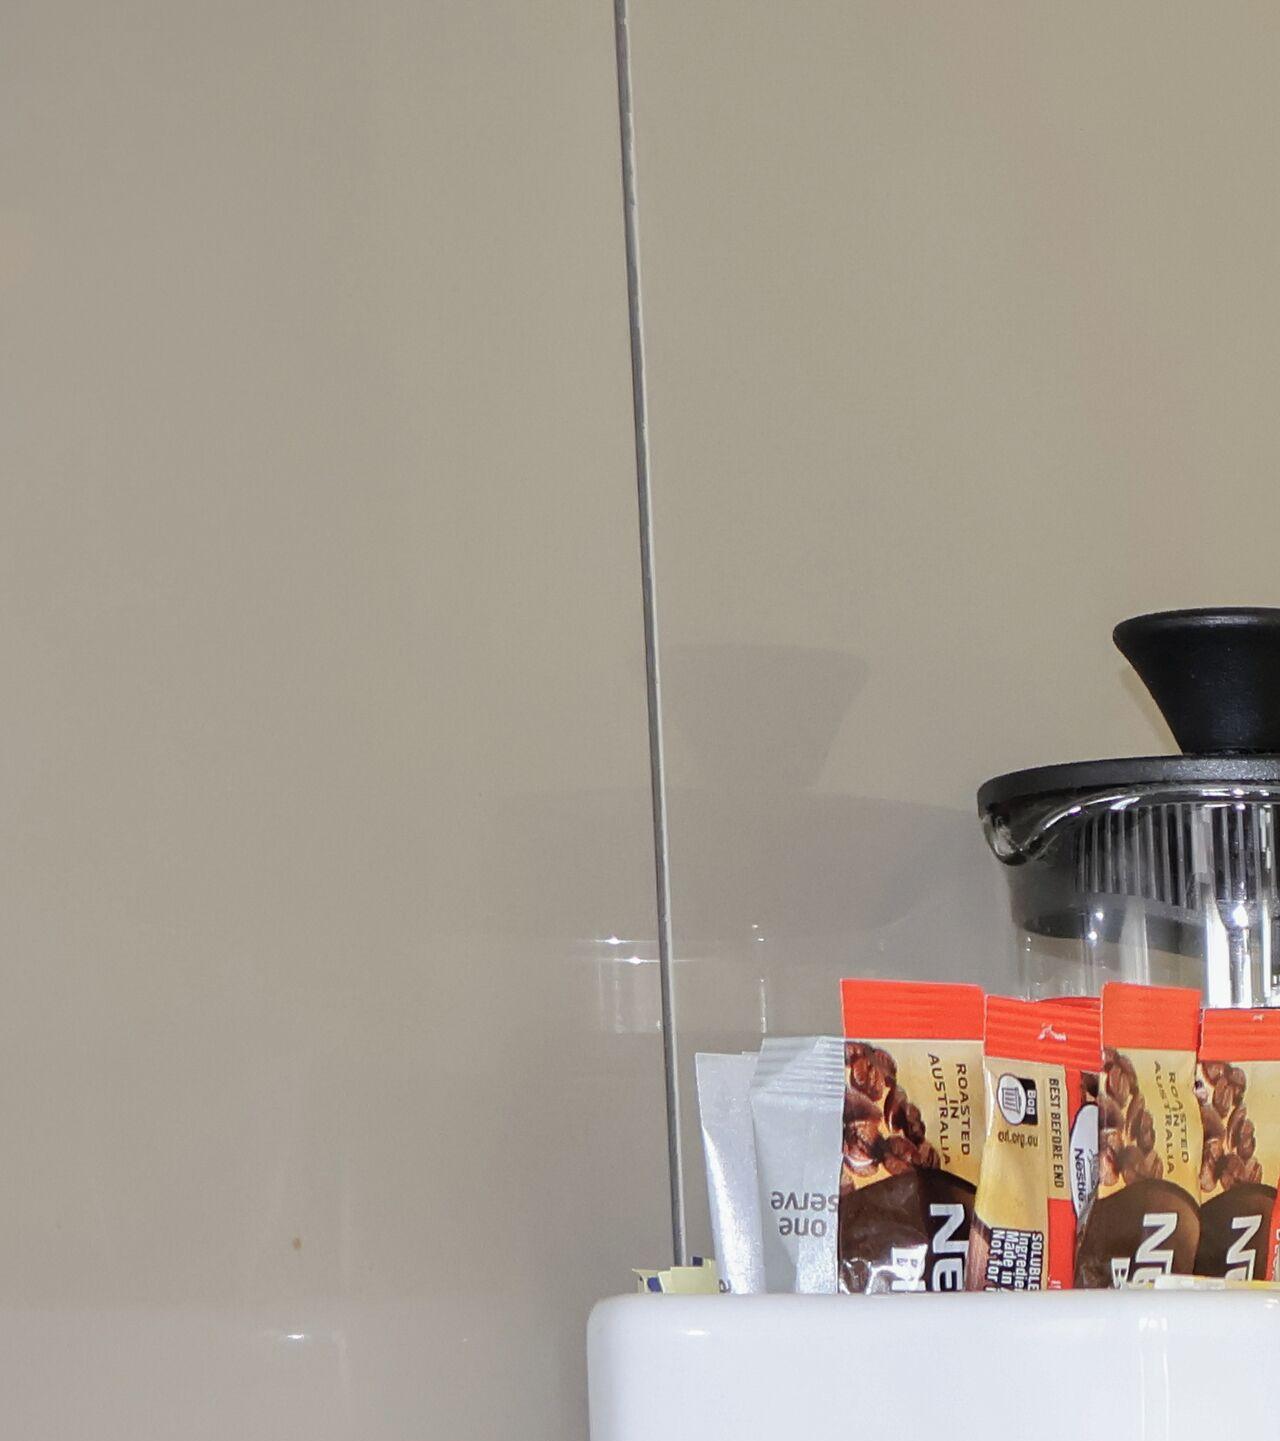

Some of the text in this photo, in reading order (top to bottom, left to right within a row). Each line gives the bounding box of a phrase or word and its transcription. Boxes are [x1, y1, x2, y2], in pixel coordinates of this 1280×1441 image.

[927, 1053, 951, 1165] AUSTRALIA
[949, 1099, 960, 1119] IN
[955, 1063, 971, 1156] ROASTED
[1153, 1061, 1175, 1176] AUSTRALIA
[1168, 1071, 1189, 1164] ROASTED
[1049, 1078, 1065, 1188] BEST BEFORE END
[770, 1191, 839, 1212] serve
[779, 1217, 827, 1237] one
[990, 1229, 1005, 1255] Not
[1003, 1231, 1019, 1268] Made
[1014, 1232, 1031, 1292] Ingredie
[987, 1260, 1003, 1283] for
[1001, 1271, 1014, 1285] in
